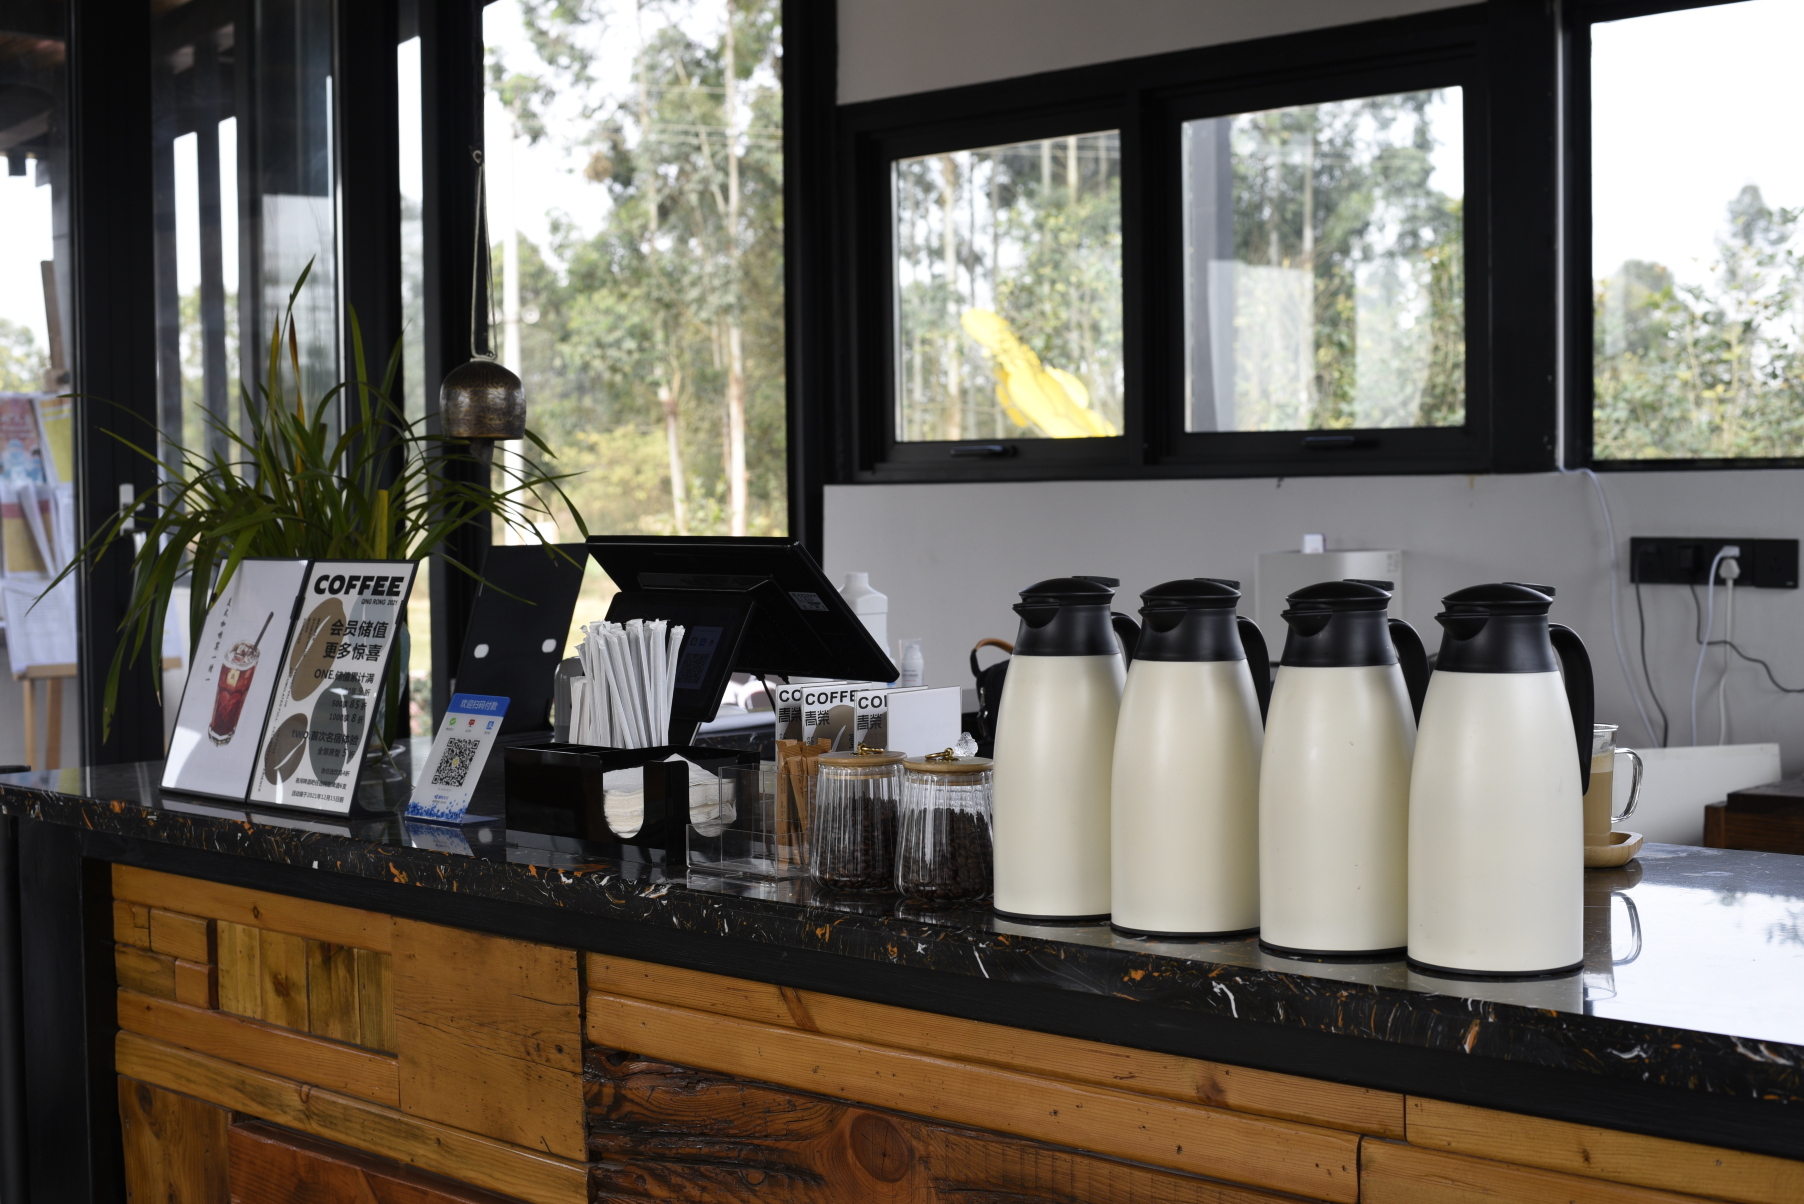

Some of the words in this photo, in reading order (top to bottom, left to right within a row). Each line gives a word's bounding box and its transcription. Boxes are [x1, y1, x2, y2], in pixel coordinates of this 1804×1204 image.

[314, 574, 404, 597] COFFEE
[330, 619, 389, 639] 会员储值
[322, 642, 382, 662] 更多惊喜
[460, 698, 498, 711] 欢迎扫码付款
